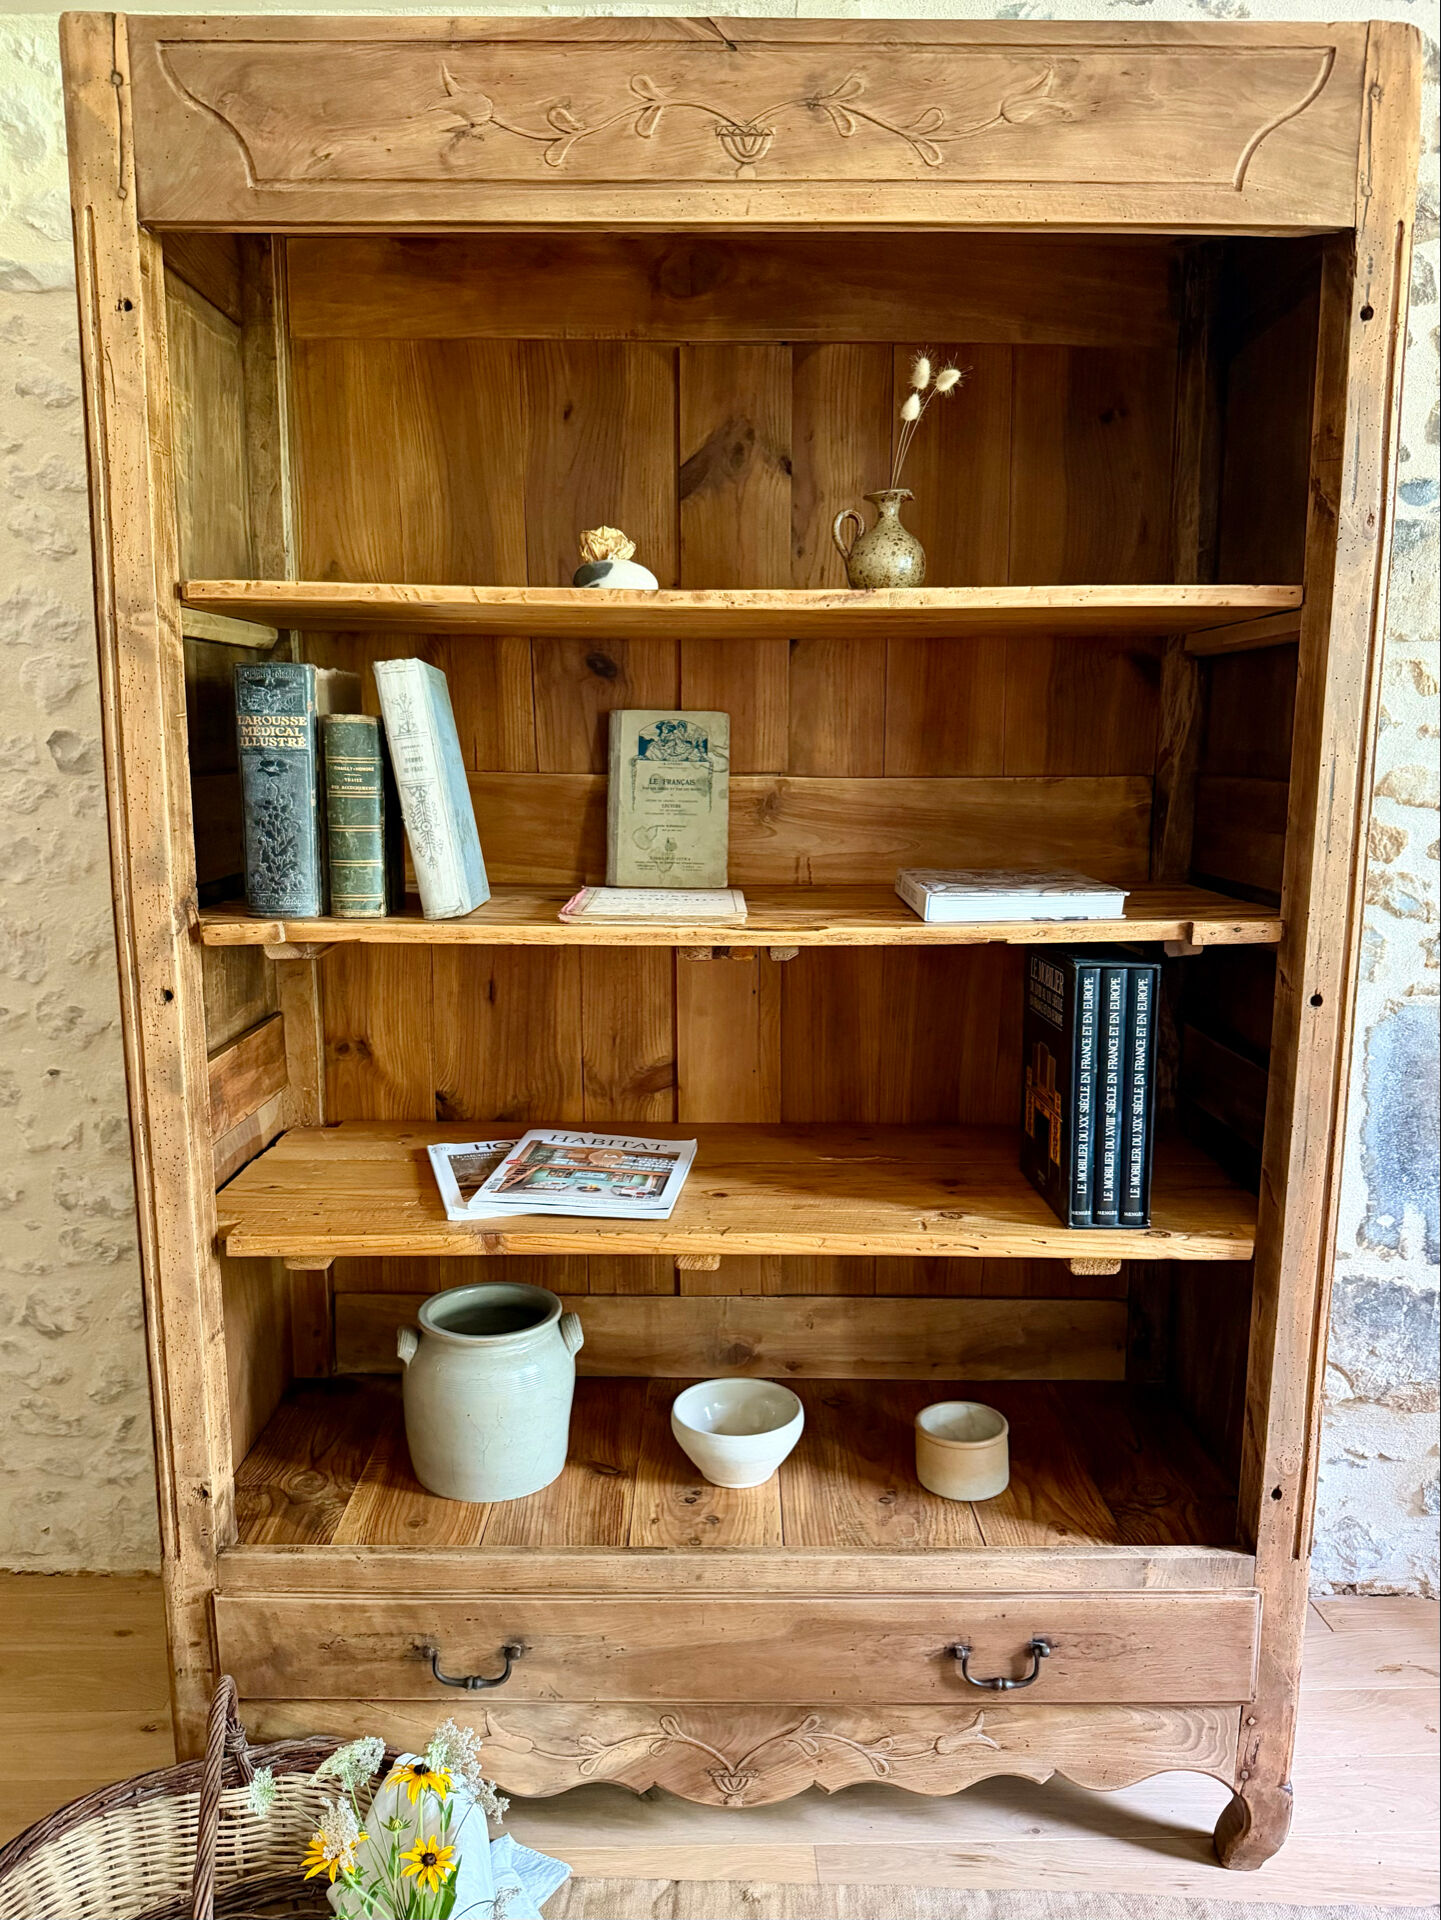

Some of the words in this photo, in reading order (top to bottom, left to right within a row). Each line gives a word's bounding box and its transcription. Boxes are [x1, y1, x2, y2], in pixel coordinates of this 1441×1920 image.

[237, 715, 308, 726] LAROUSSE
[242, 725, 304, 736] MÉDICAL
[240, 736, 307, 747] ILLUSTRÉ
[649, 777, 659, 785] LE
[662, 778, 697, 786] FRANÇAIS
[1083, 976, 1093, 1009] EUROPE
[1110, 976, 1120, 1009] EUROPE
[1137, 977, 1148, 1010] EUROPE
[1083, 1011, 1092, 1023] EN
[1110, 1011, 1119, 1023] EN
[1137, 1012, 1146, 1024] EN
[1083, 1024, 1092, 1035] ET
[1109, 1025, 1119, 1035] ET
[1136, 1026, 1146, 1036] ET
[1081, 1036, 1092, 1069] FRANCE
[1108, 1037, 1118, 1069] FRANCE
[1135, 1038, 1145, 1070] FRANCE
[1081, 1071, 1090, 1083] EN
[1107, 1072, 1117, 1083] EN
[1135, 1073, 1145, 1085] EN
[1079, 1085, 1090, 1113] SIÈCLE
[1105, 1085, 1116, 1113] SIÈCLE
[1132, 1086, 1143, 1115] SIÈCLE
[1079, 1129, 1088, 1141] DU
[1132, 1134, 1142, 1146] DU
[474, 1141, 519, 1150] HO
[550, 1134, 668, 1151] HABITAT
[1105, 1137, 1115, 1149] DU
[1078, 1142, 1088, 1181] MOBILIER
[1131, 1147, 1141, 1185] MOBILIER
[1104, 1150, 1114, 1189] MOBILIER
[1077, 1182, 1087, 1194] LE
[1130, 1187, 1140, 1198] LE
[1104, 1190, 1113, 1201] LE
